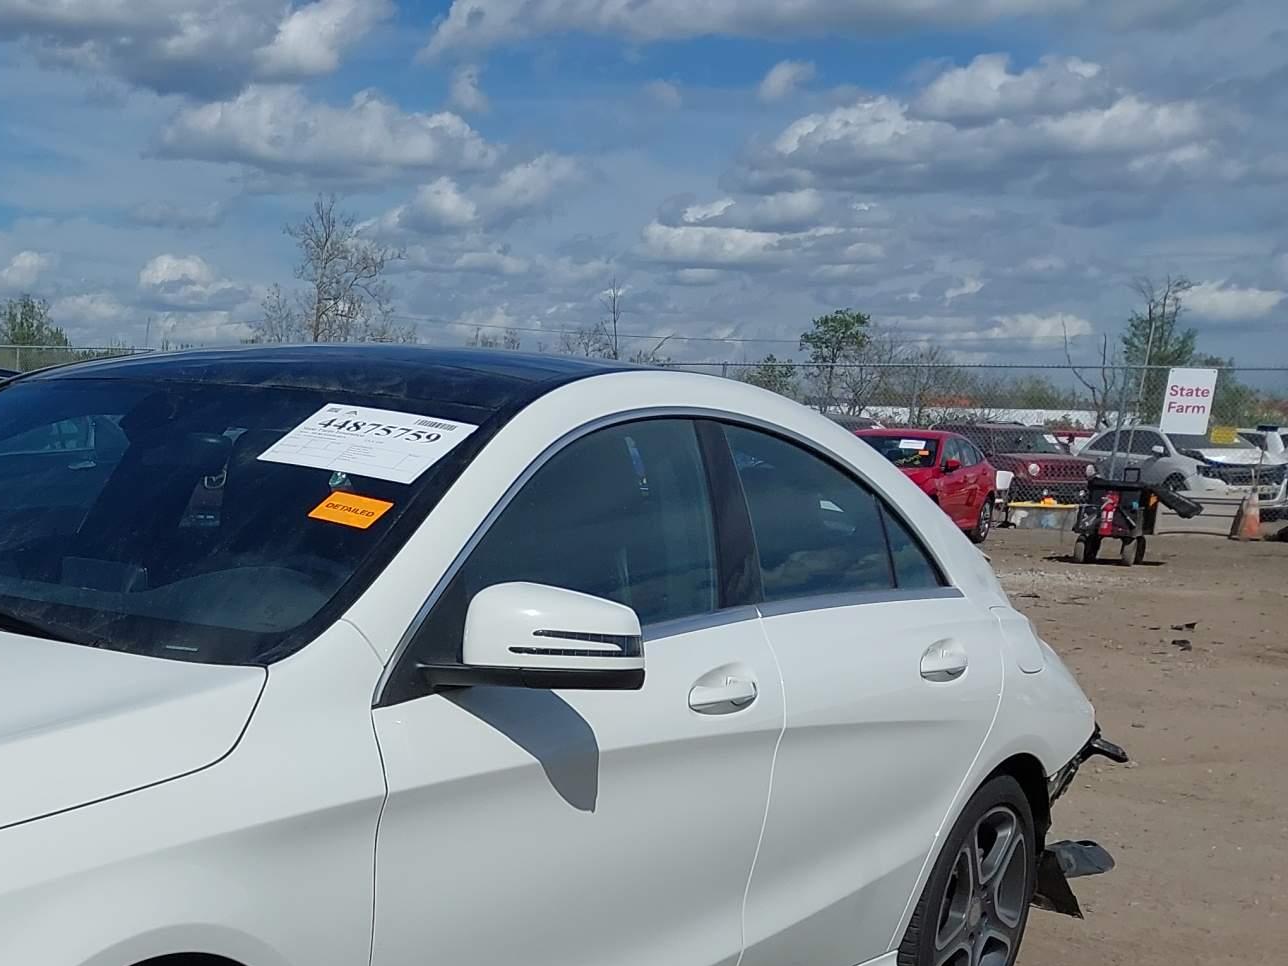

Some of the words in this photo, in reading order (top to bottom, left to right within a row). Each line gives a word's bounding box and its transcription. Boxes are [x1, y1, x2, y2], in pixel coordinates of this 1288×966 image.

[1169, 384, 1210, 398] State
[1167, 401, 1206, 415] Farm
[318, 418, 442, 443] 44875759
[326, 502, 375, 518] DETAILED
